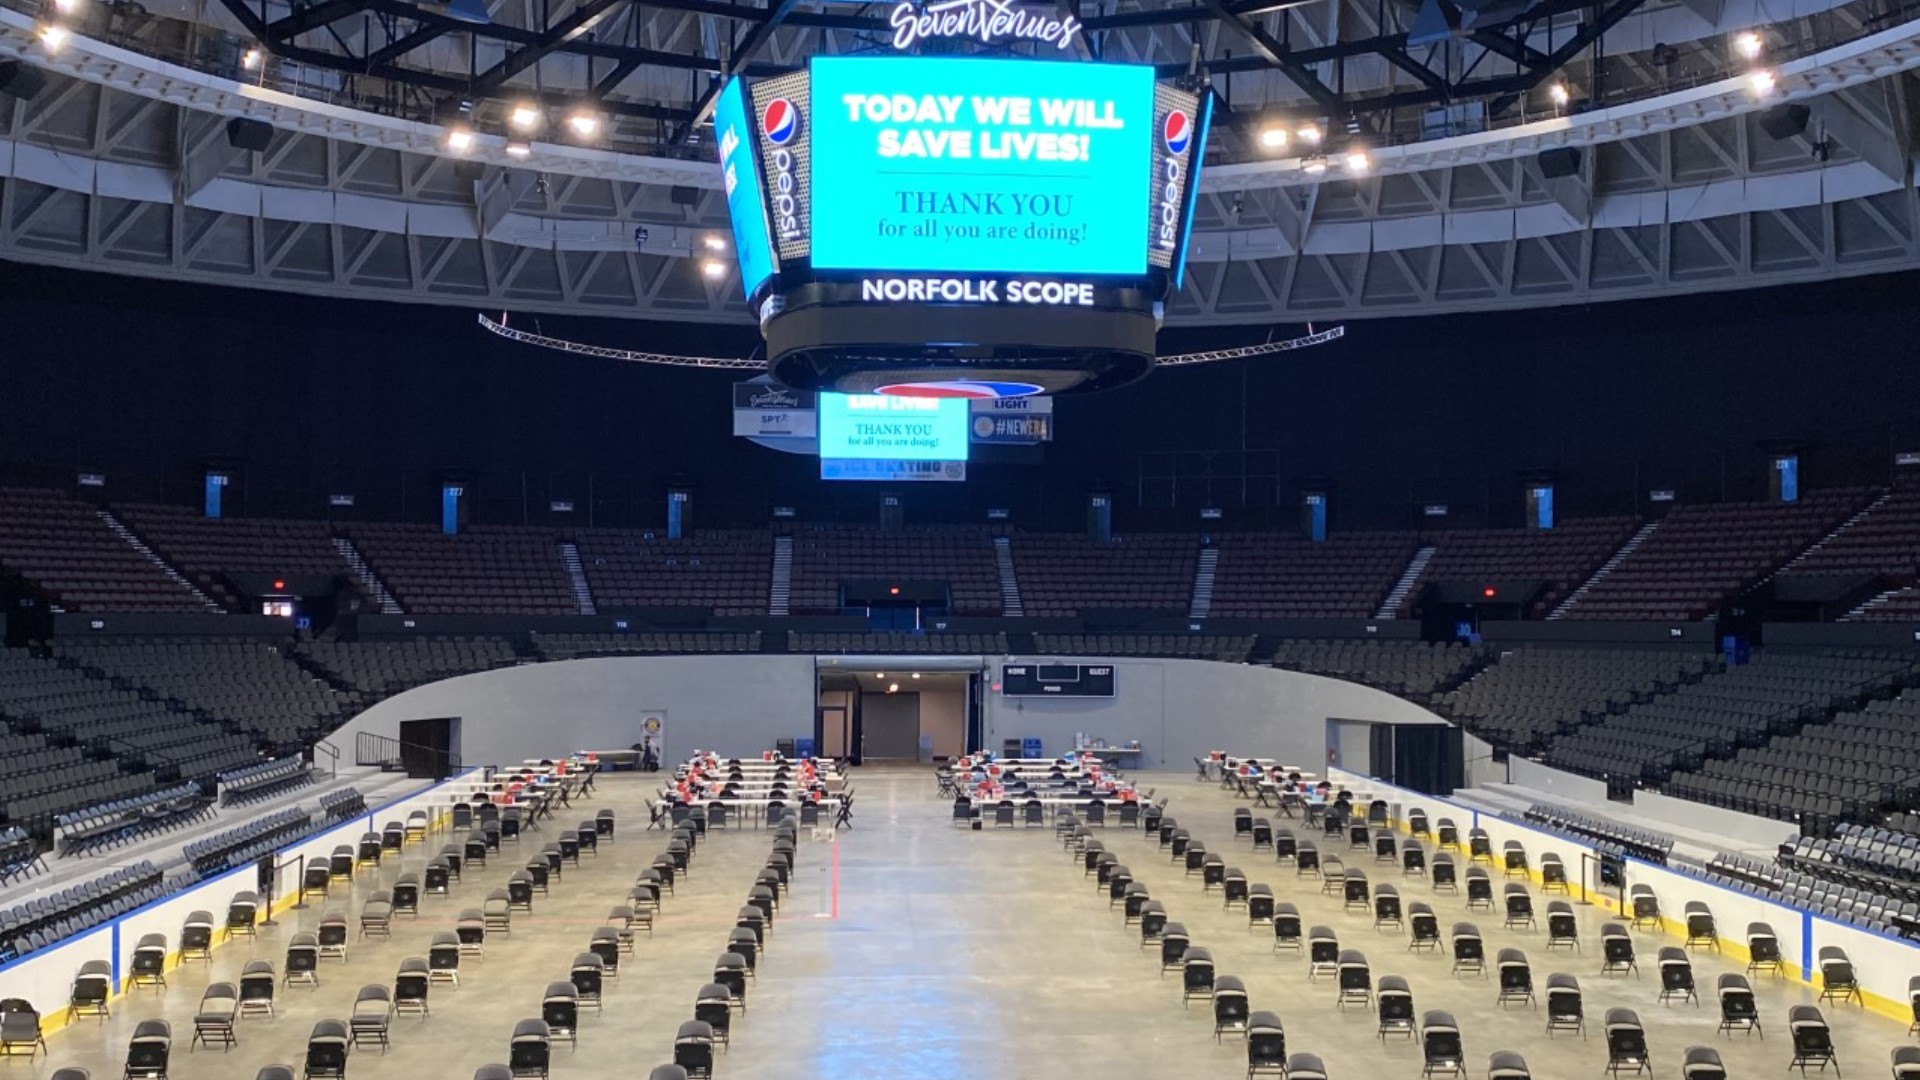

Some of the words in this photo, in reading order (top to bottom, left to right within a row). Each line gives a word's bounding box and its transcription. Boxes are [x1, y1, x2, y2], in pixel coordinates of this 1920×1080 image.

[890, 1, 1082, 49] SevenVenues
[842, 94, 964, 123] TODAY
[971, 95, 1032, 126] WE
[1038, 97, 1125, 129] WILL
[876, 129, 972, 159] SAVE
[979, 131, 1091, 162] LIVES!
[772, 149, 800, 239] pepsi
[895, 190, 1005, 216] THANK
[1010, 192, 1074, 217] YOU
[1159, 157, 1180, 249] pepsi
[877, 218, 908, 238] for
[912, 219, 938, 238] all
[943, 224, 980, 243] you
[986, 224, 1018, 240] are
[1023, 221, 1088, 246] doing!
[861, 278, 999, 302] NORFOLK
[1006, 280, 1094, 306] SCOPE
[994, 400, 1029, 409] LIGHT
[848, 436, 860, 446] for
[863, 437, 874, 446] all
[876, 438, 892, 448] you
[895, 438, 909, 446] are
[910, 438, 939, 449] doing!
[855, 423, 902, 435] THANK
[904, 424, 933, 436] YOU
[1089, 668, 1110, 676] GUEST
